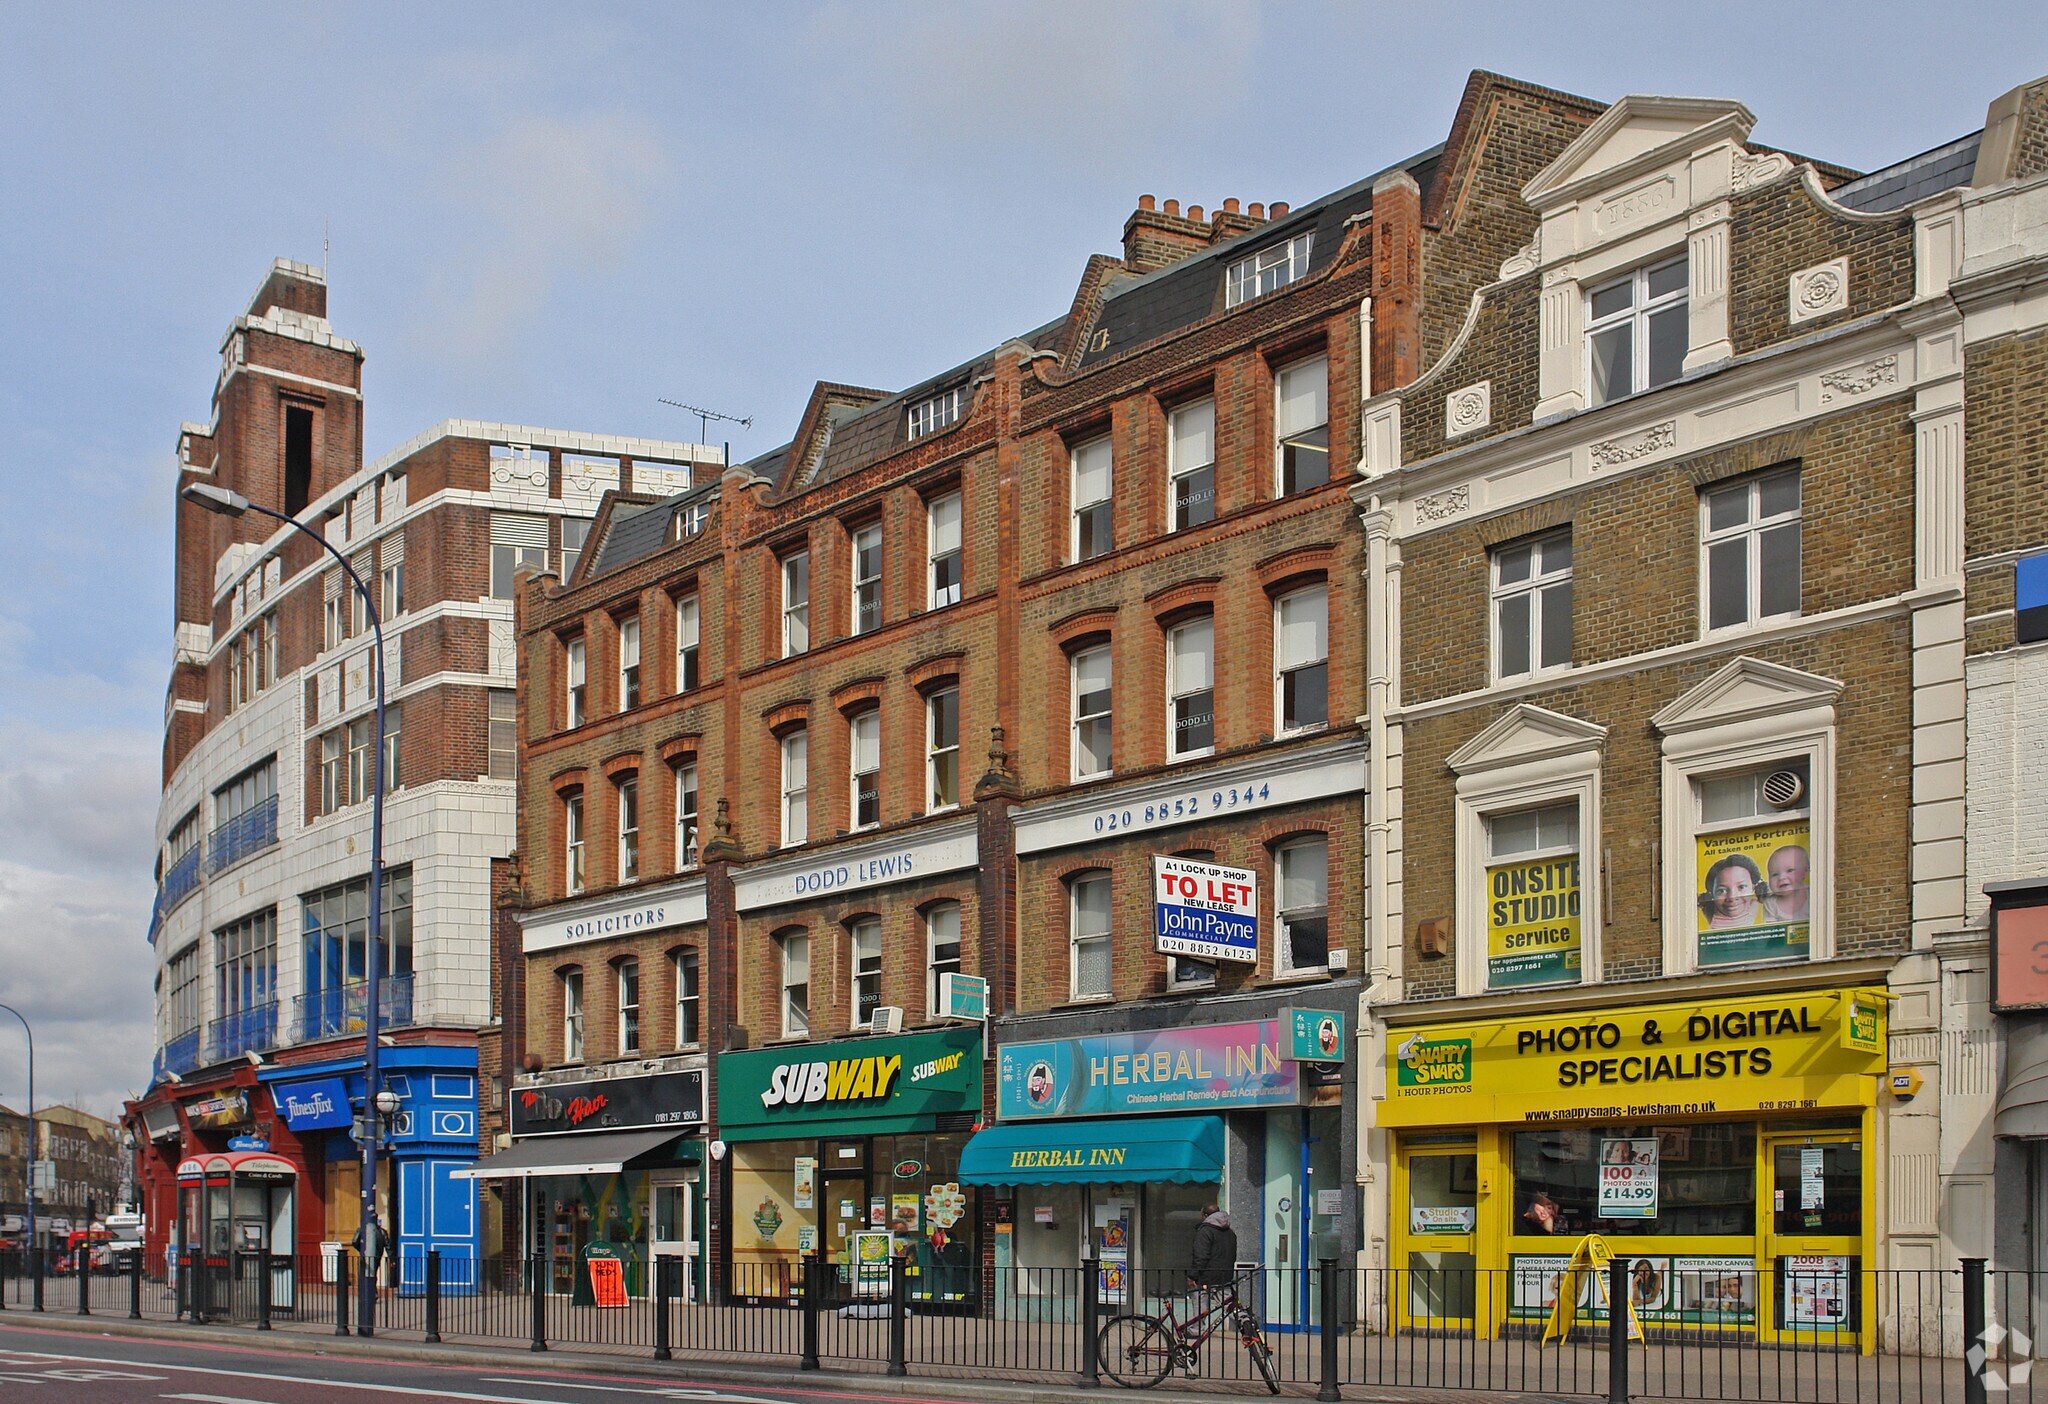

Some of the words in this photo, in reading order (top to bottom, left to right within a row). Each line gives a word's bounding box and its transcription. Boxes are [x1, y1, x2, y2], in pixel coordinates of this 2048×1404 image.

[1176, 493, 1201, 508] DODD
[1175, 716, 1201, 729] DODD
[1094, 810, 1131, 833] 020
[1144, 797, 1198, 823] 8852
[1212, 782, 1270, 810] 9344
[1703, 836, 1750, 848] Various
[1753, 826, 1810, 841] Portraits
[795, 867, 848, 894] DODD
[859, 853, 913, 881] LEWIS
[1180, 864, 1207, 875] LOCK
[1208, 868, 1221, 877] UP
[1223, 870, 1247, 881] SHOP
[1493, 861, 1580, 898] ONSITE
[1160, 873, 1199, 898] TO
[1207, 879, 1252, 907] LET
[1183, 898, 1205, 908] NEW
[1206, 901, 1235, 912] LEASE
[1493, 890, 1580, 927] STUDIO
[565, 907, 665, 939] SOLICITORS
[1162, 907, 1203, 934] John
[1205, 913, 1254, 942] Payne
[1169, 929, 1223, 943] COMMERCIAL
[1505, 927, 1570, 949] service
[1162, 939, 1184, 951] 020
[1190, 942, 1218, 956] 8852
[1224, 947, 1252, 960] 6125
[1502, 955, 1544, 965] appointments
[1544, 952, 1559, 960] call,
[1505, 964, 1523, 972] 8297
[1525, 962, 1541, 970] 1661
[1517, 1022, 1621, 1055] PHOTO
[1640, 1018, 1663, 1046] &
[1688, 1006, 1822, 1042] DIGITAL
[1090, 1049, 1213, 1087] HERBAL
[1224, 1042, 1281, 1077] INN
[1406, 1043, 1468, 1069] SNAPPY
[910, 1051, 964, 1083] SUBWAY
[1415, 1063, 1465, 1083] SNAPS
[1558, 1047, 1773, 1088] SPECIALISTS
[691, 1073, 700, 1083] 73
[760, 1053, 902, 1109] SUBWAY
[1893, 1076, 1910, 1087] ADT
[1126, 1094, 1158, 1104] Chinese
[1159, 1092, 1186, 1102] Herbal
[1187, 1089, 1220, 1101] Remedy
[1221, 1088, 1237, 1098] and
[1238, 1085, 1291, 1098] Acupuncture
[1404, 1087, 1431, 1097] HOUR
[1433, 1085, 1472, 1095] PHOTOS
[1525, 1100, 1716, 1121] www.snappysnaps-lewisham.co.uk
[1758, 1101, 1775, 1110] 020
[1777, 1100, 1797, 1109] 8297
[1799, 1099, 1818, 1108] 1661
[655, 1112, 669, 1123] 0181
[669, 1111, 682, 1122] 297
[682, 1110, 698, 1121] 1806
[1010, 1150, 1086, 1168] HERBAL
[1088, 1147, 1127, 1166] INN
[897, 1163, 918, 1174] OPEN
[1603, 1166, 1632, 1180] 100
[1603, 1188, 1654, 1199] £14.99
[1428, 1208, 1459, 1217] Studio
[800, 1241, 810, 1250] £2
[1791, 1255, 1824, 1264] 2008
[1660, 1311, 1681, 1320] 1661
